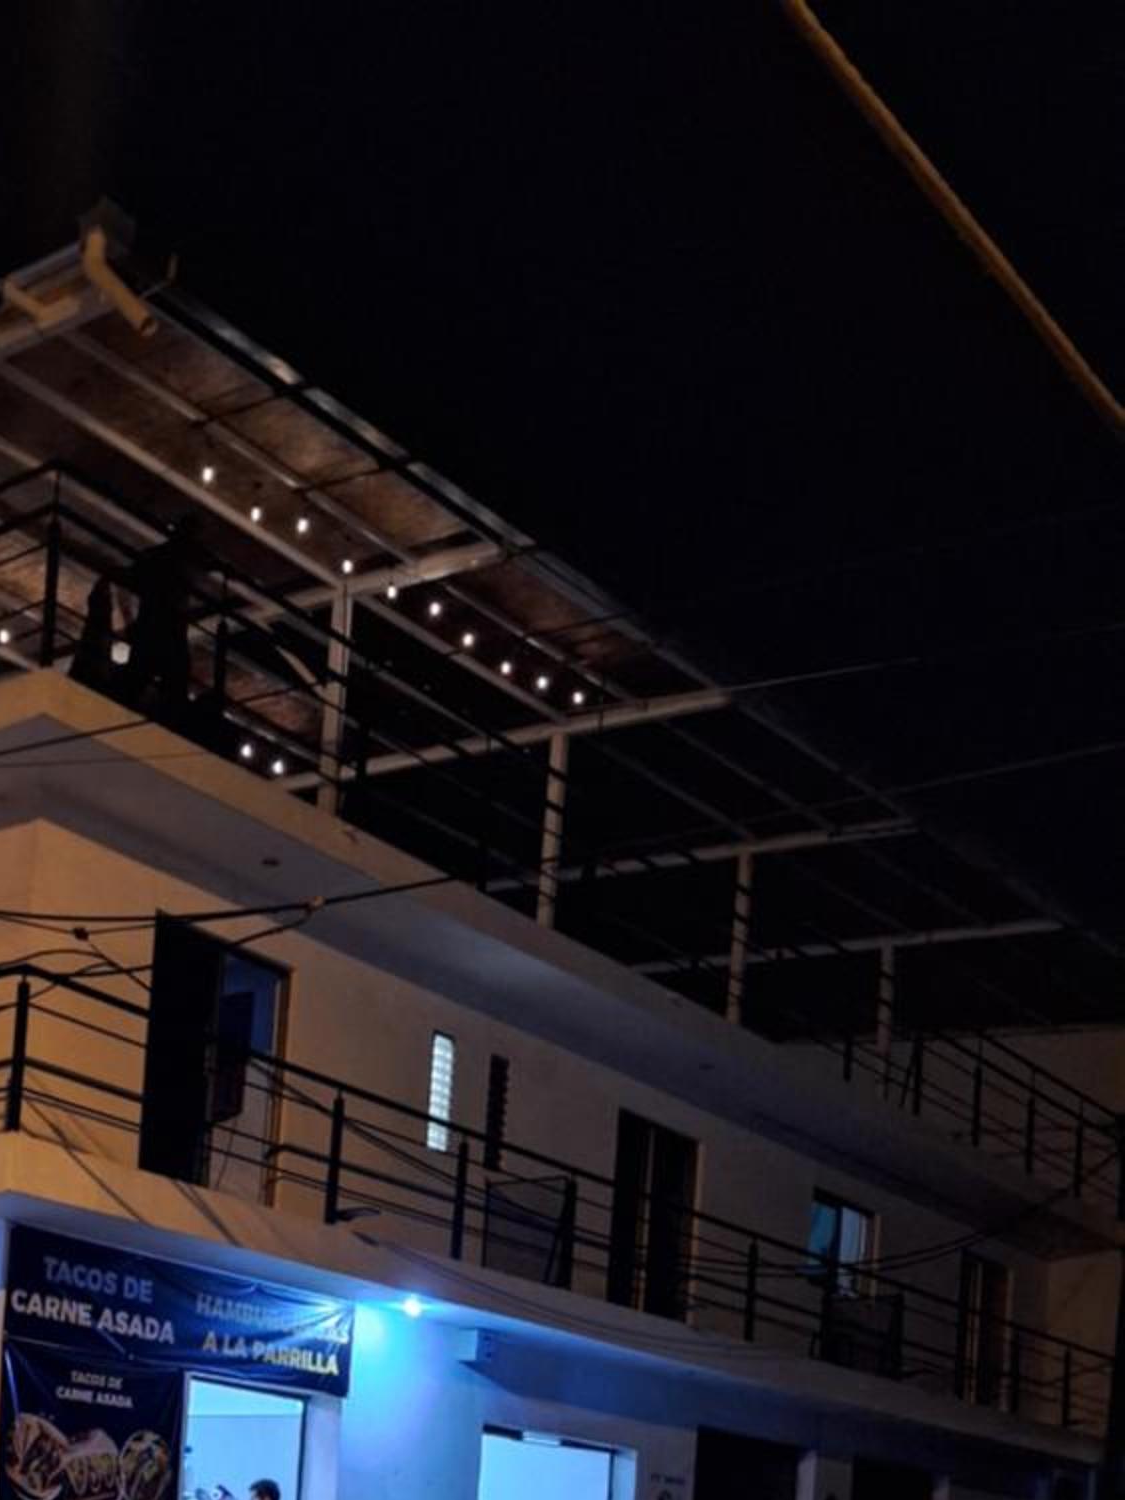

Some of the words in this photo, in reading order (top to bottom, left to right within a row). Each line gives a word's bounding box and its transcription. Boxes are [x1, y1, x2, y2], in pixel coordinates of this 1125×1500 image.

[43, 1256, 118, 1295] TACOS
[123, 1276, 154, 1304] DE
[10, 1288, 93, 1327] CARNE
[97, 1307, 175, 1345] ASADA
[203, 1330, 217, 1353] A
[222, 1334, 248, 1358] LA
[252, 1340, 340, 1376] PARRILLA
